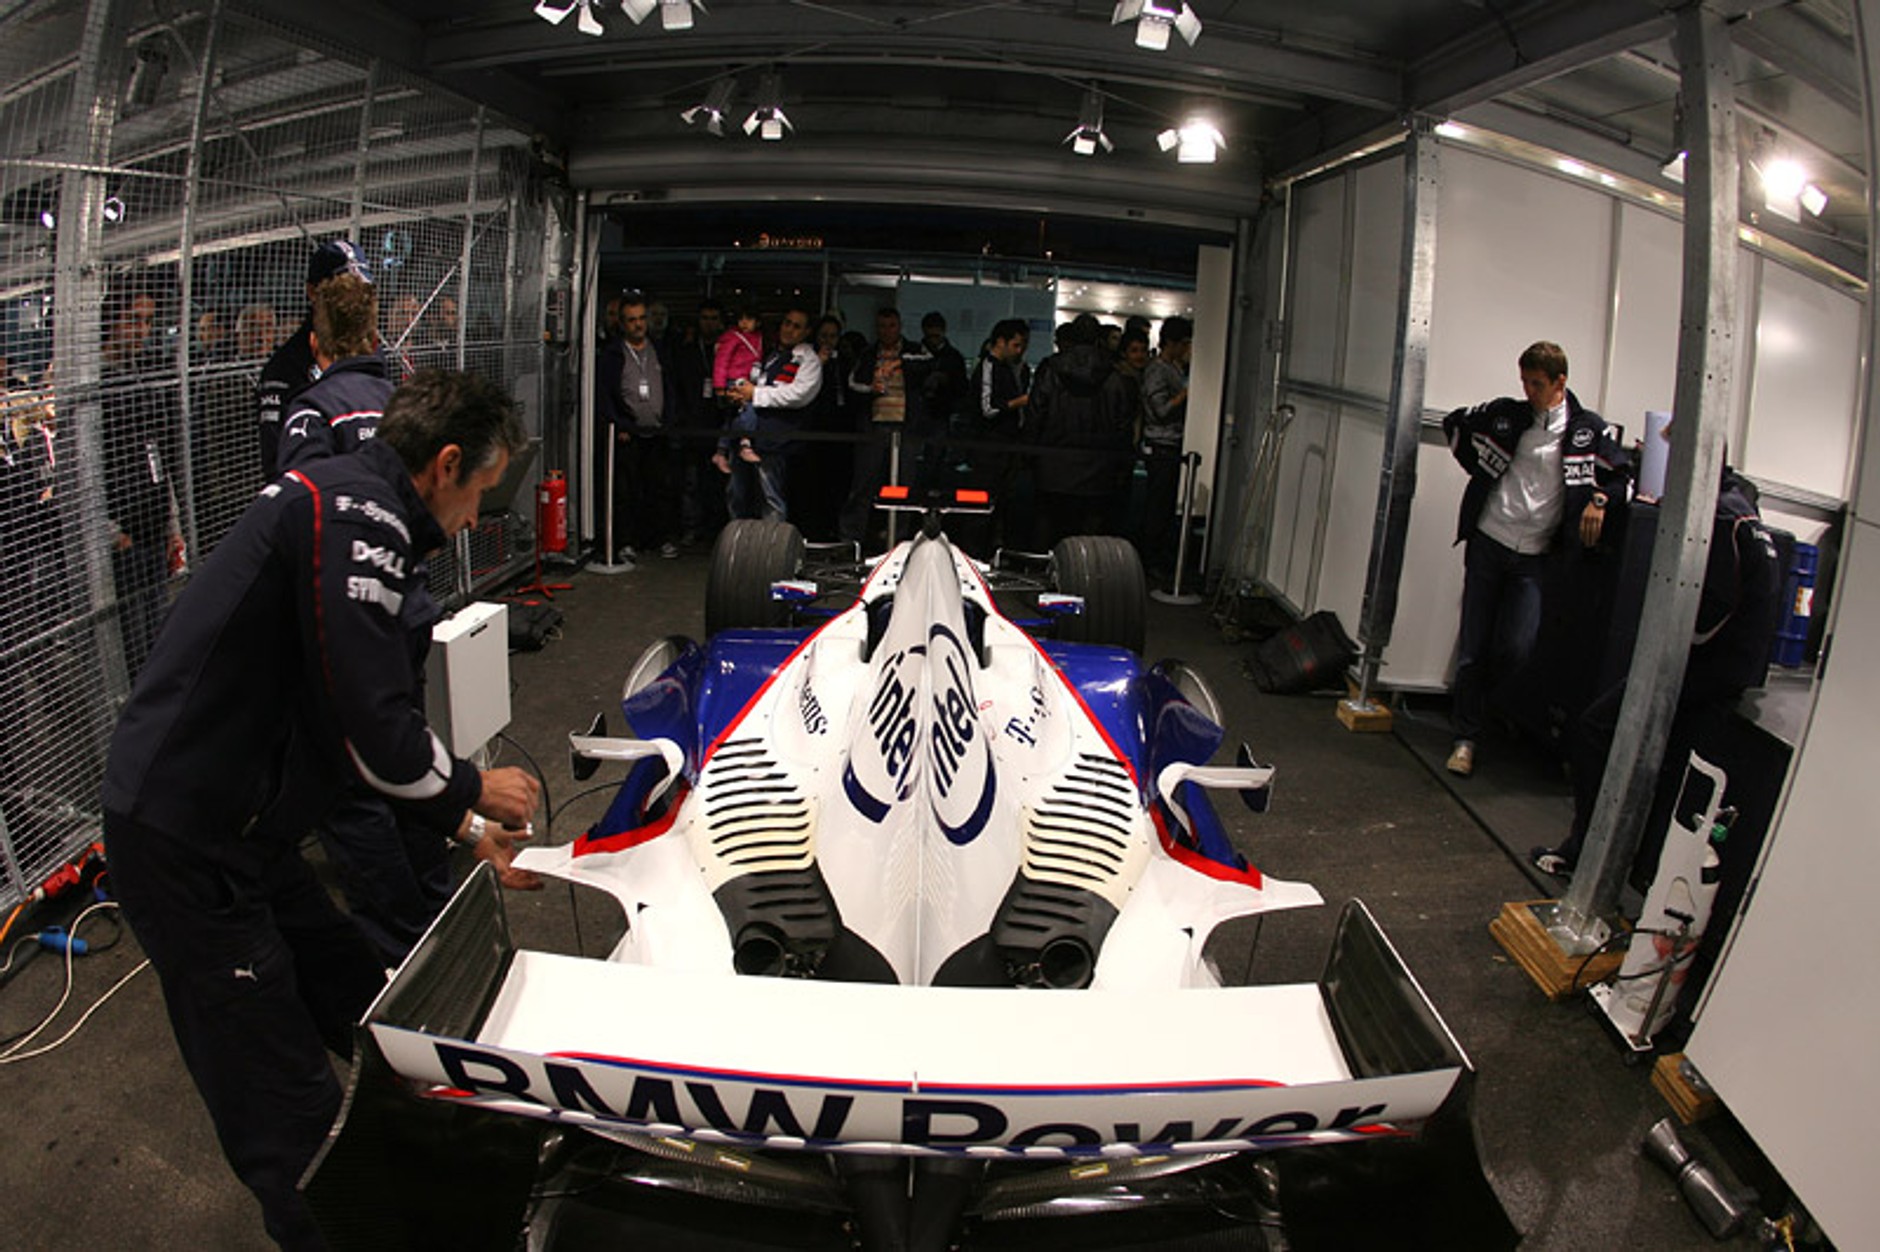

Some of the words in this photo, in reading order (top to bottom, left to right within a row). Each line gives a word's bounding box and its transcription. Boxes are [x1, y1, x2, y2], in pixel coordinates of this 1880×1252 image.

[352, 540, 405, 579] DELL
[868, 651, 924, 793] intel
[929, 655, 978, 798] intel
[902, 1097, 1388, 1147] Power
